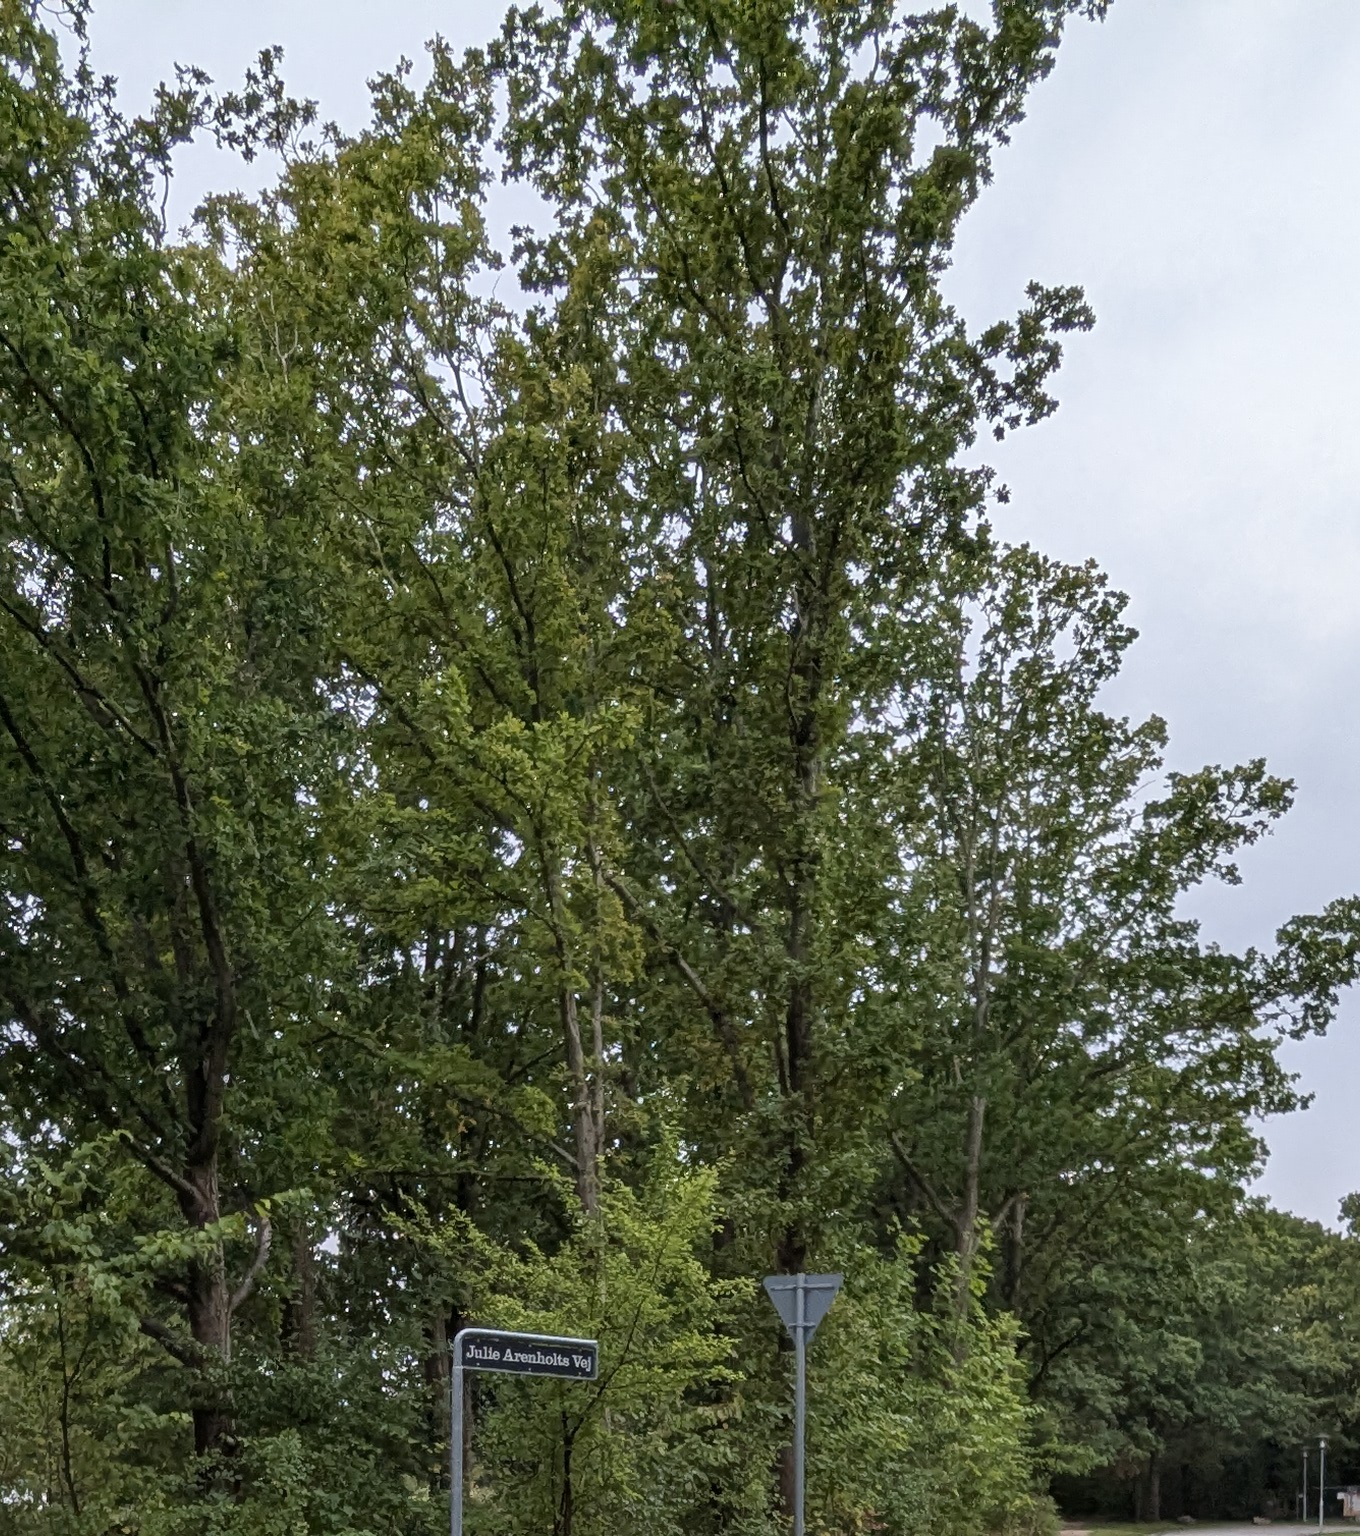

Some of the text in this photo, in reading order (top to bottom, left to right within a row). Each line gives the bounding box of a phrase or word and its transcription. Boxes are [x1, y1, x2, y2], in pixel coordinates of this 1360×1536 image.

[466, 1345, 592, 1371] Julie Arenholts Vej
